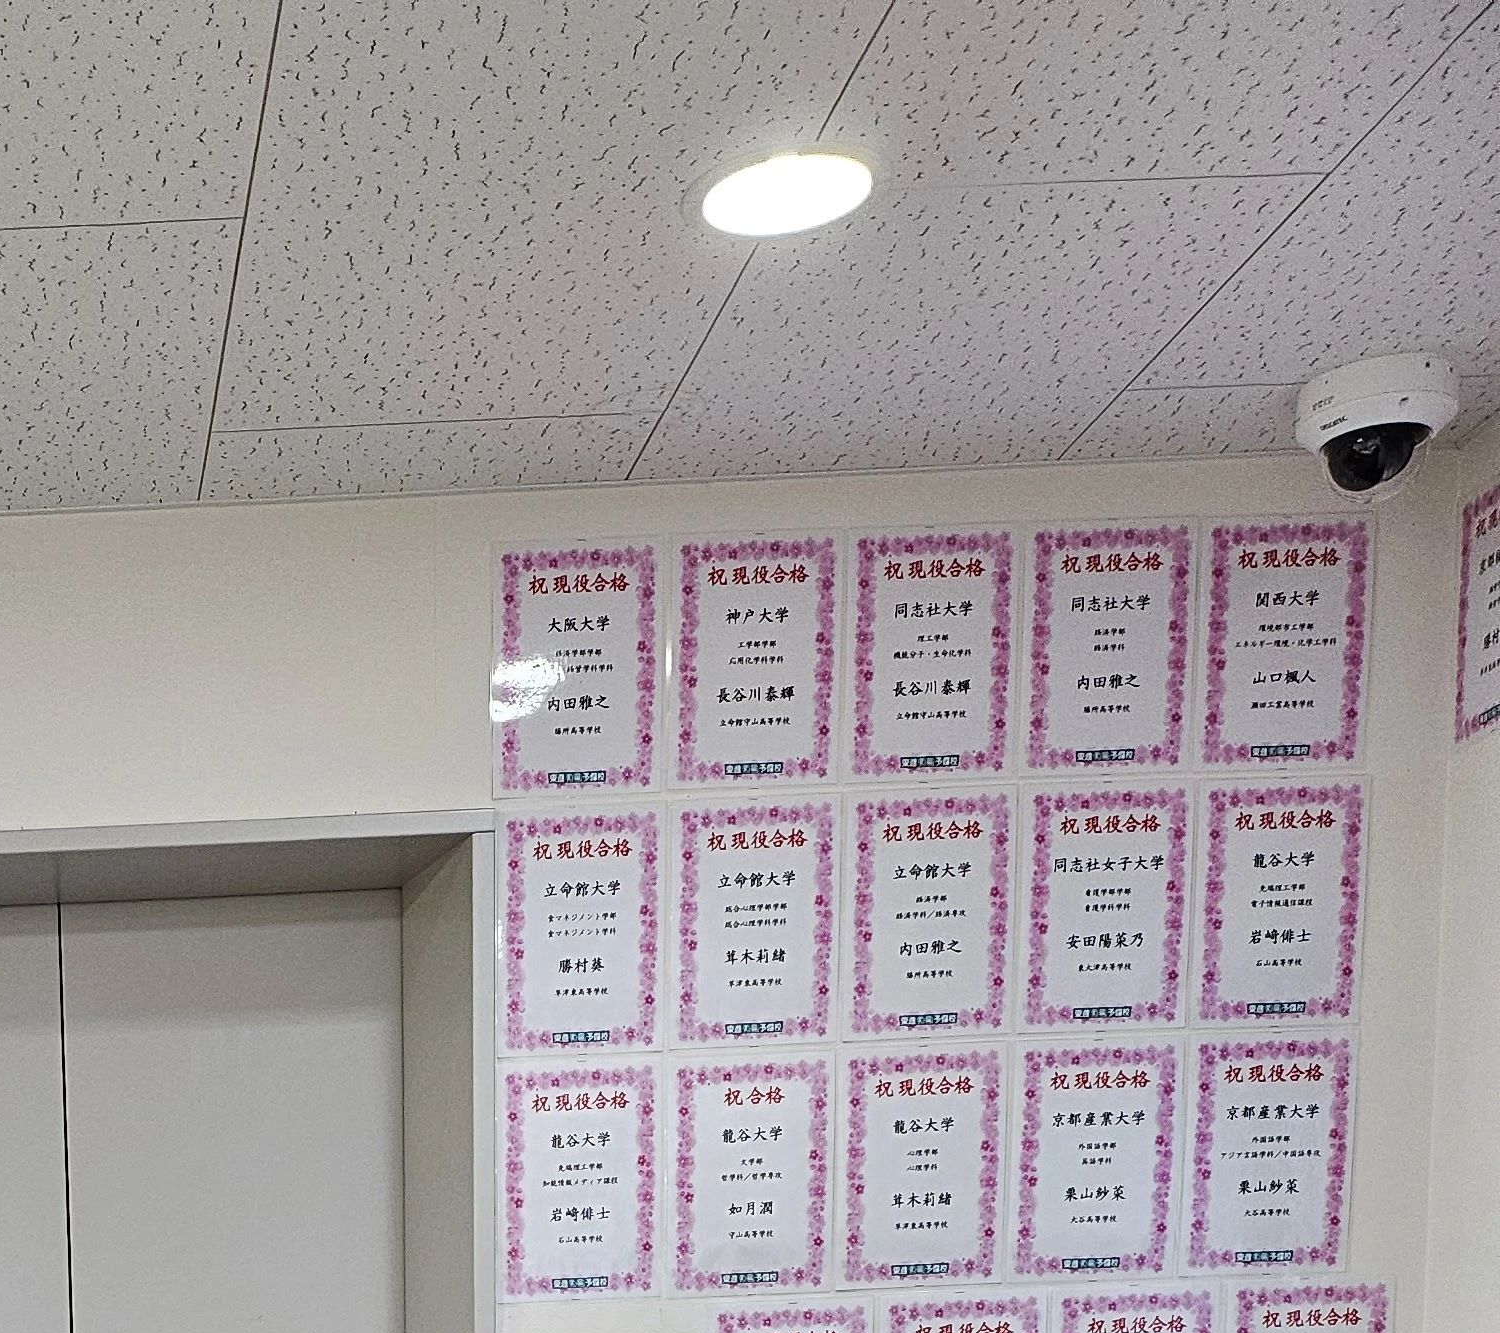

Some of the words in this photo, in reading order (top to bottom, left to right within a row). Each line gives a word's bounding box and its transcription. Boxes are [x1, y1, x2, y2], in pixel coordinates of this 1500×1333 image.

[1072, 594, 1150, 612] 同志社大学
[1256, 590, 1319, 607] 関西大学
[726, 607, 788, 624] 神戸大学
[895, 600, 972, 618] 同志社大学
[548, 615, 609, 633] 大阪大学
[1078, 674, 1140, 690] 内田雅之
[1253, 670, 1316, 684] 山口楓人
[717, 686, 794, 703] 長谷川泰輝
[893, 679, 971, 697] 長谷川泰輝
[548, 695, 609, 711] 内田雅之
[1054, 855, 1164, 873] 同志社女子大学
[1252, 851, 1314, 868] 龍谷大学
[718, 870, 795, 888] 立命館大学
[893, 862, 971, 880] 立命館大学
[544, 880, 620, 898] 立命館大学
[900, 940, 961, 956] 内田雅之
[1066, 932, 1143, 949] 安田陽菜乃
[559, 957, 604, 973] 勝村葵
[1053, 1110, 1145, 1127] 京都産業大学
[1227, 1104, 1319, 1120] 京都産業大学
[893, 1117, 954, 1134] 龍谷大学
[551, 1132, 610, 1148] 龍谷大学
[722, 1126, 782, 1143] 龍谷大学
[741, 1158, 763, 1166] 文学部
[728, 1201, 773, 1215] 如月潤
